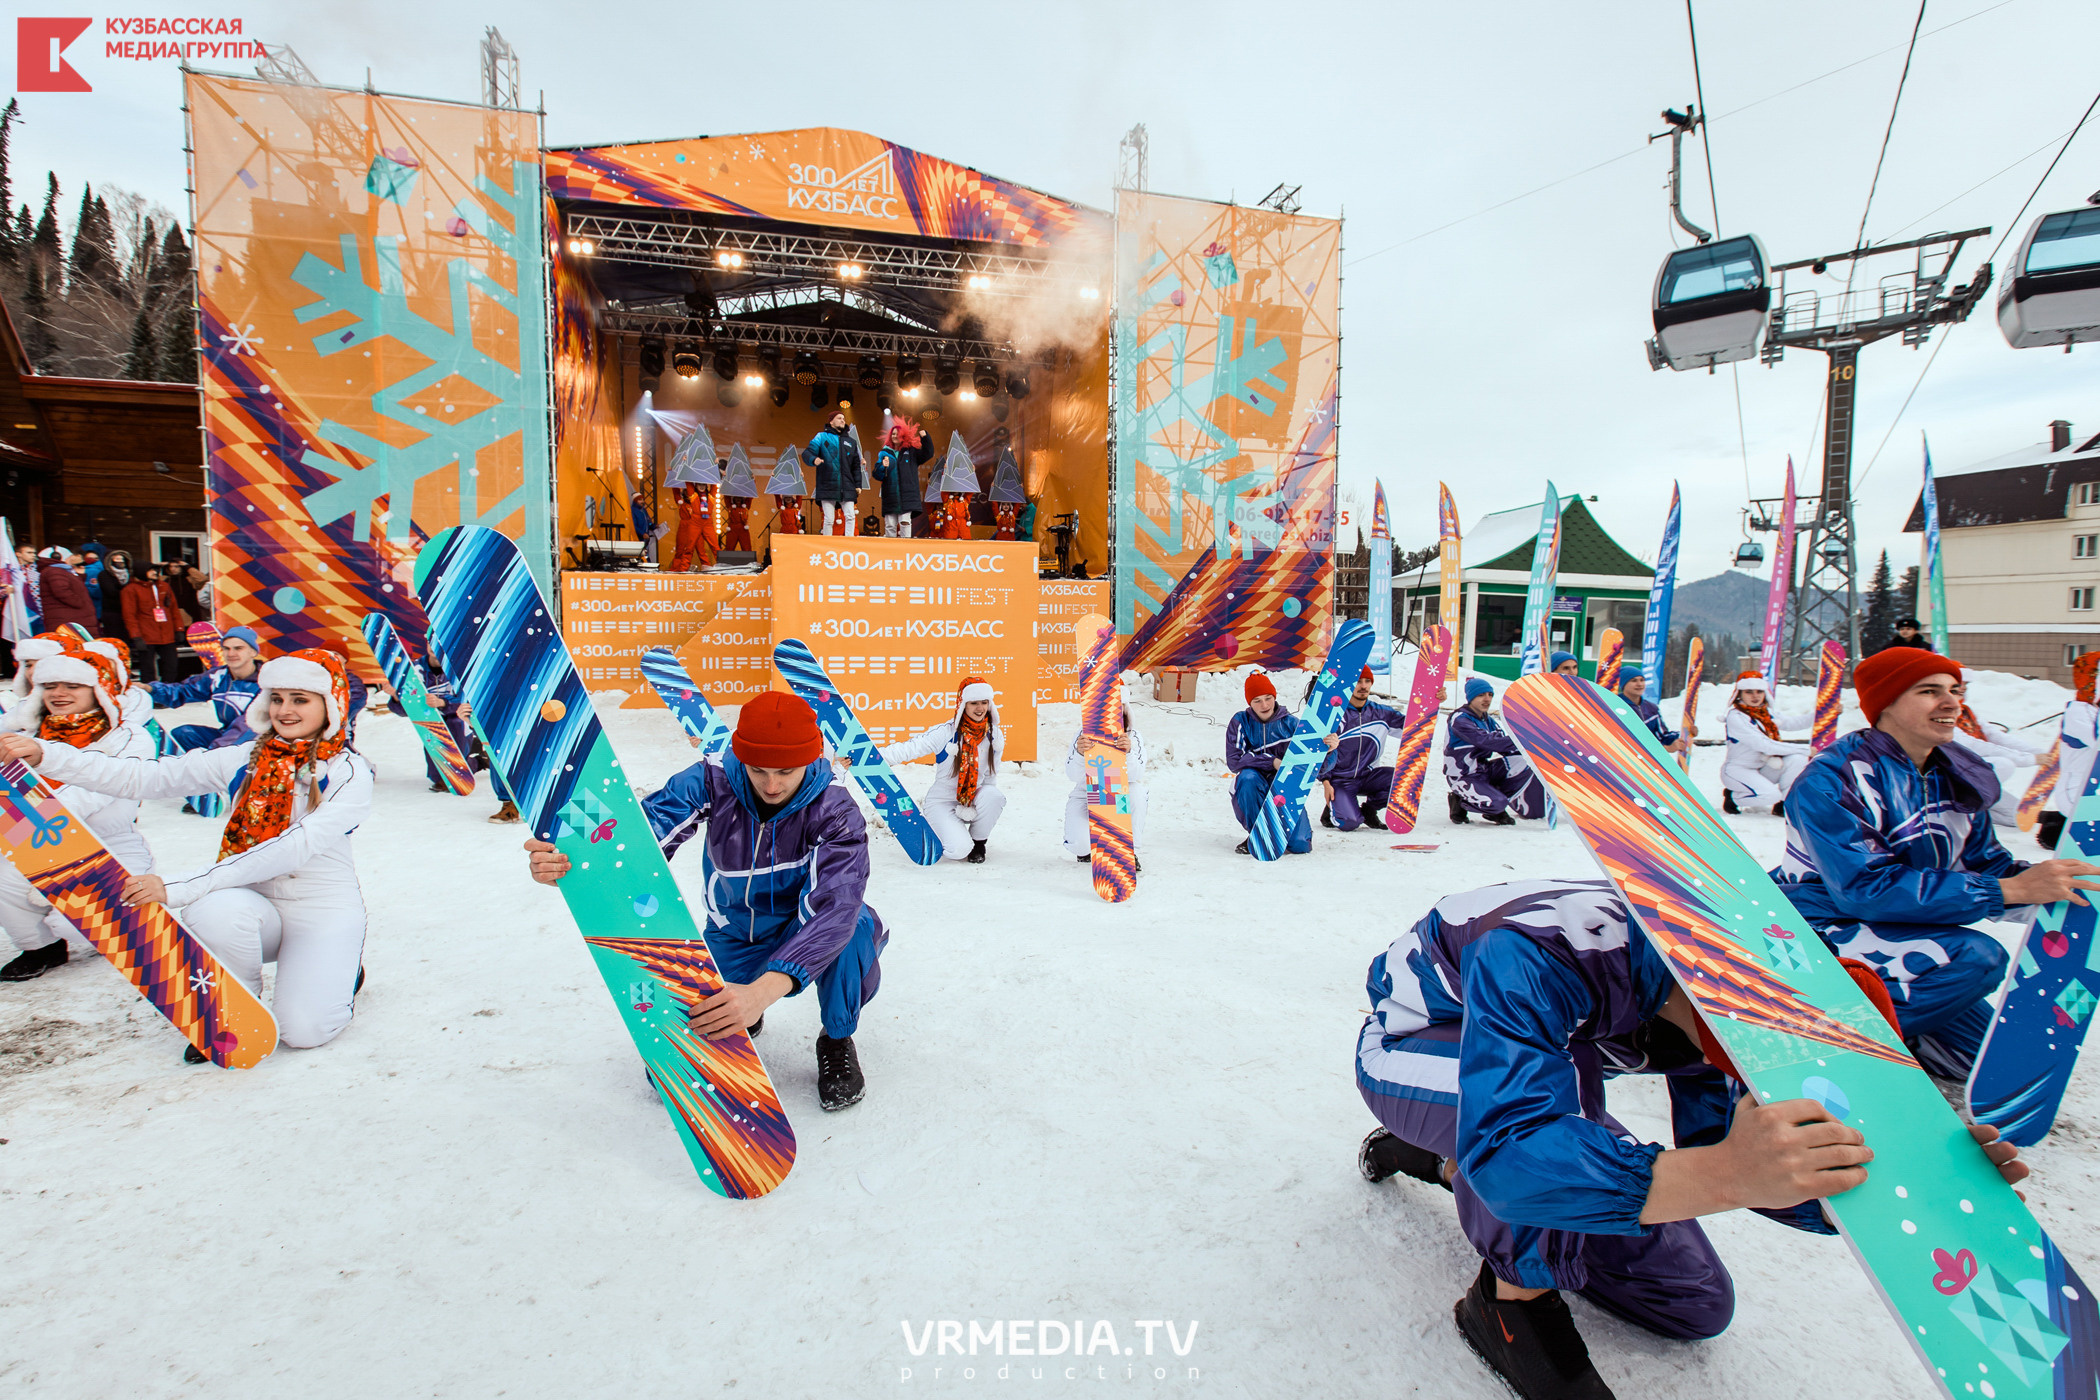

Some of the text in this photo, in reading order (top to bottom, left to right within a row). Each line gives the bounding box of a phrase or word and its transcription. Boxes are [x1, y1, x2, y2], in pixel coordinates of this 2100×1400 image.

[788, 163, 837, 186] 300
[788, 187, 898, 219] КУЗБАСС
[1830, 364, 1855, 381] 10
